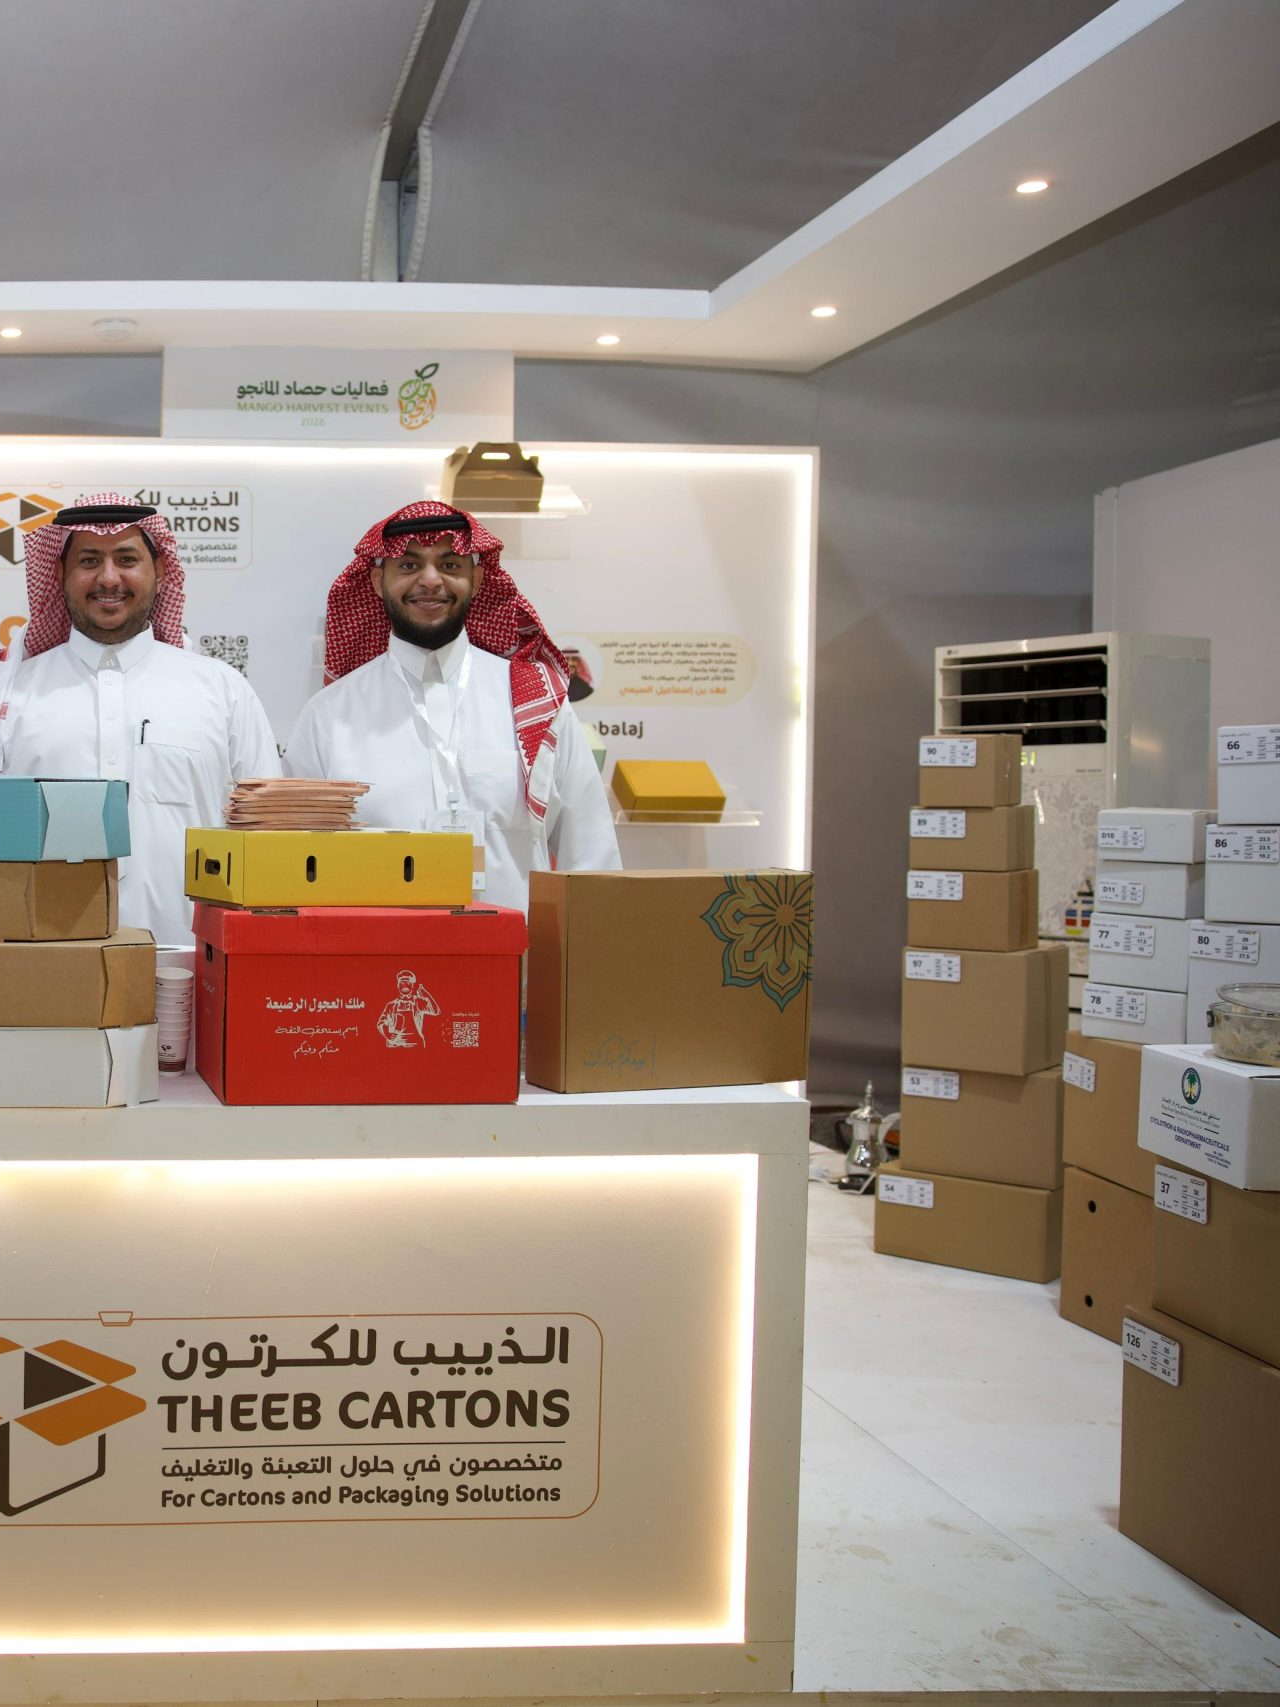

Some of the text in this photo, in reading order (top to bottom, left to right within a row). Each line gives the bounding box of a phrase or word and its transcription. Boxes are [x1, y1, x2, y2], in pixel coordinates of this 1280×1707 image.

[237, 380, 389, 400] فعاليات حصاد المانجو
[237, 402, 388, 413] MANGO HARVEST EVENTS
[167, 490, 239, 511] الذييب
[163, 516, 240, 532] ARTONS
[194, 555, 237, 563] Solutions
[1227, 741, 1240, 750] 66
[1215, 839, 1227, 848] 86
[1099, 930, 1109, 939] 77
[1197, 936, 1210, 945] 80
[266, 997, 365, 1012] ملك العجول الرضيعة
[1090, 996, 1101, 1004] 78
[294, 1040, 339, 1059] منكم وفيكم
[1175, 1135, 1201, 1150] DEPARTMENT
[1161, 1182, 1170, 1194] 37
[1127, 1333, 1140, 1348] 126
[161, 1323, 570, 1380] الذييب للكرتون
[157, 1388, 570, 1433] THEEB CARTONS
[161, 1453, 562, 1481] متخصصون في حلول التعبئة والتغليف
[161, 1484, 561, 1508] For Cartons and Packaging Solutions
